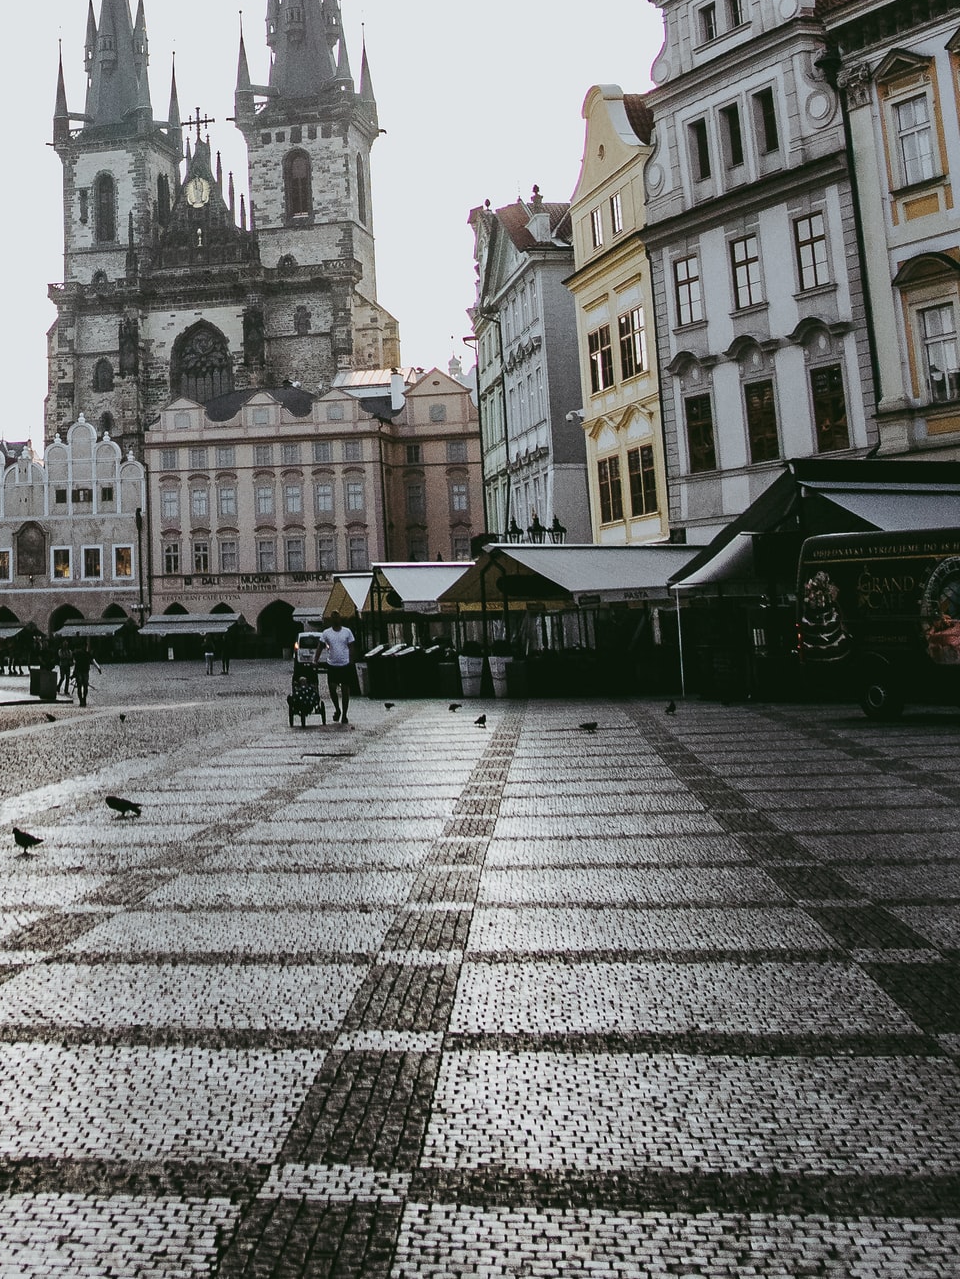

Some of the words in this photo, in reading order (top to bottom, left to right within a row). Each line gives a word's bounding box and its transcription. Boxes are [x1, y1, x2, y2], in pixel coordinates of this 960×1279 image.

[240, 575, 271, 584] MUCHA
[292, 573, 329, 583] WARHOL
[237, 583, 277, 591] exhibition
